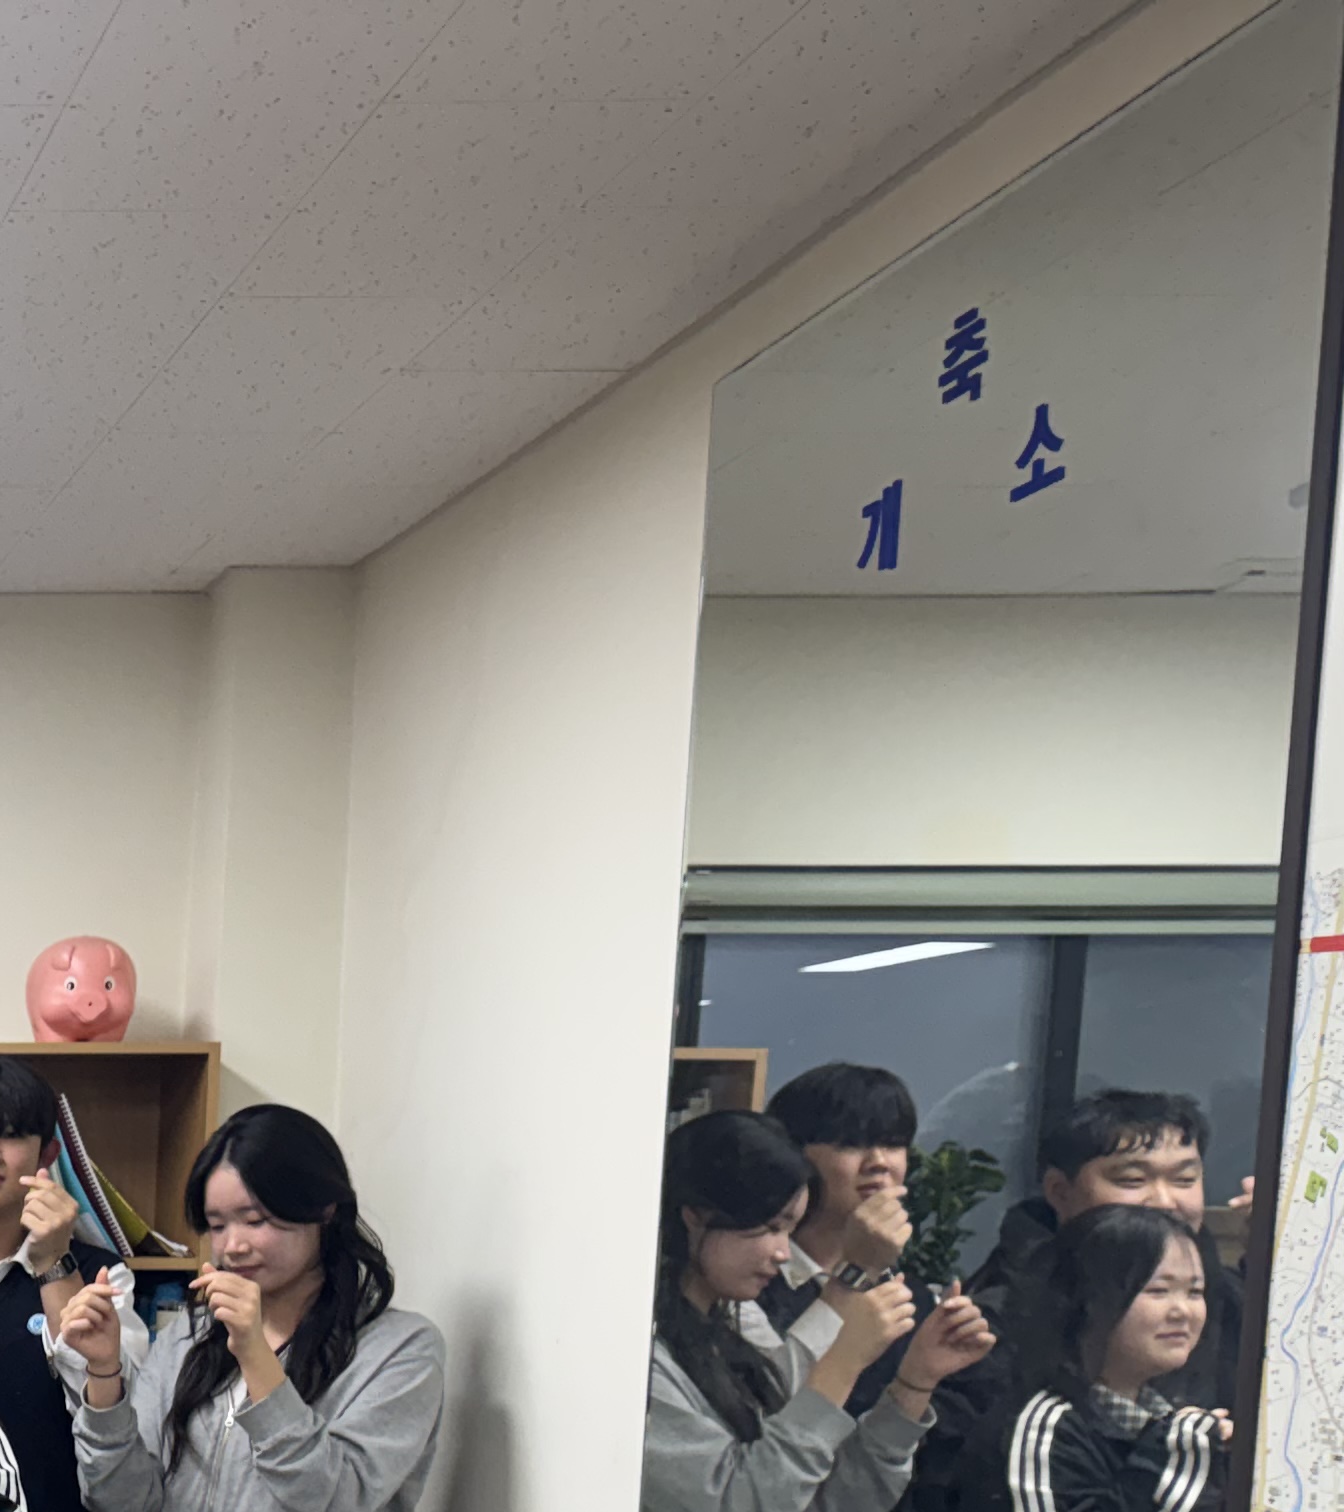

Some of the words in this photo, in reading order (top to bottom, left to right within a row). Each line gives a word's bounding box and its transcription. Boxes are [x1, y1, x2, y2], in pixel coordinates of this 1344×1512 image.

[938, 307, 989, 404] 축
[857, 479, 903, 571] 개
[1010, 403, 1066, 503] 소
